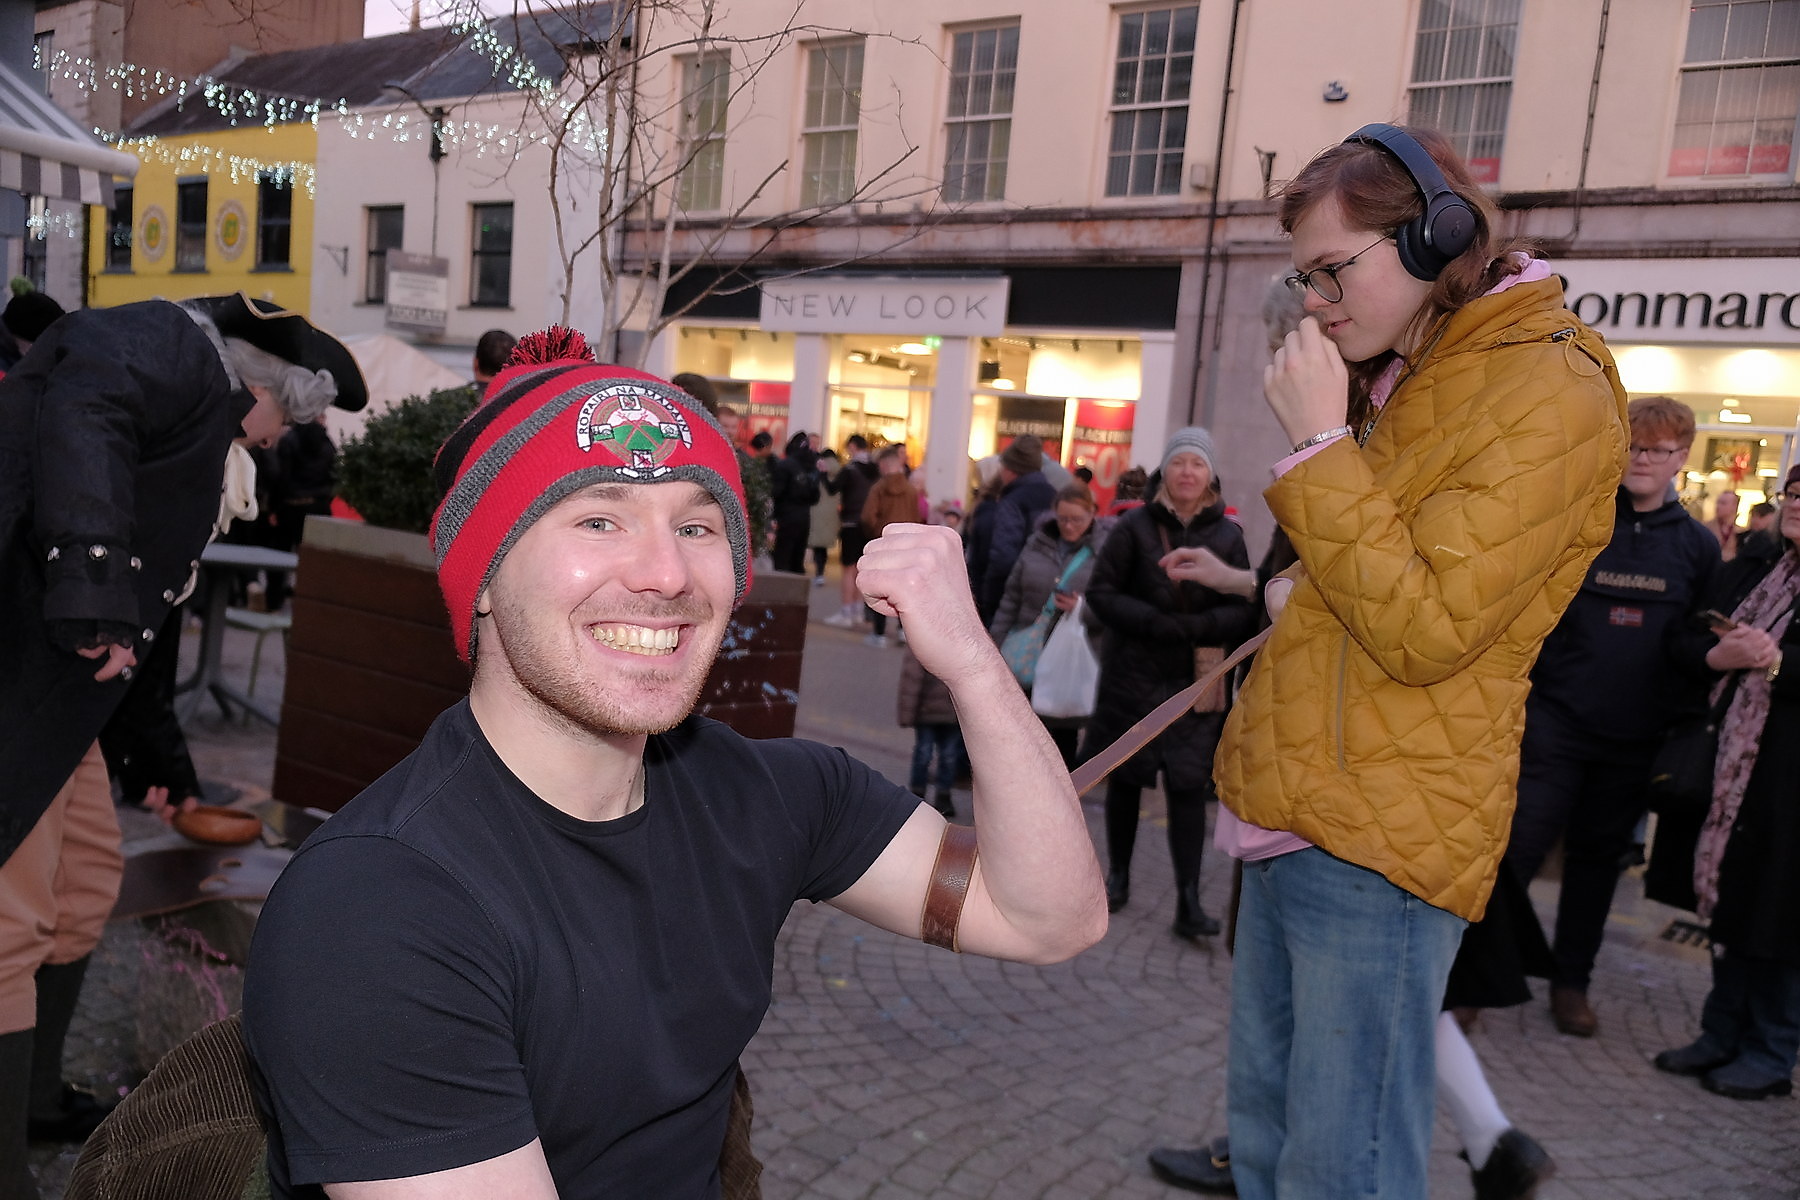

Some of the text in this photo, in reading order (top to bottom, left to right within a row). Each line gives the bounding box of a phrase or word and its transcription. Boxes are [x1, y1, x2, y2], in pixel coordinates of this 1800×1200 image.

[774, 294, 988, 320] NEW LOOK
[1551, 273, 1800, 329] onmarc
[616, 386, 637, 396] NA
